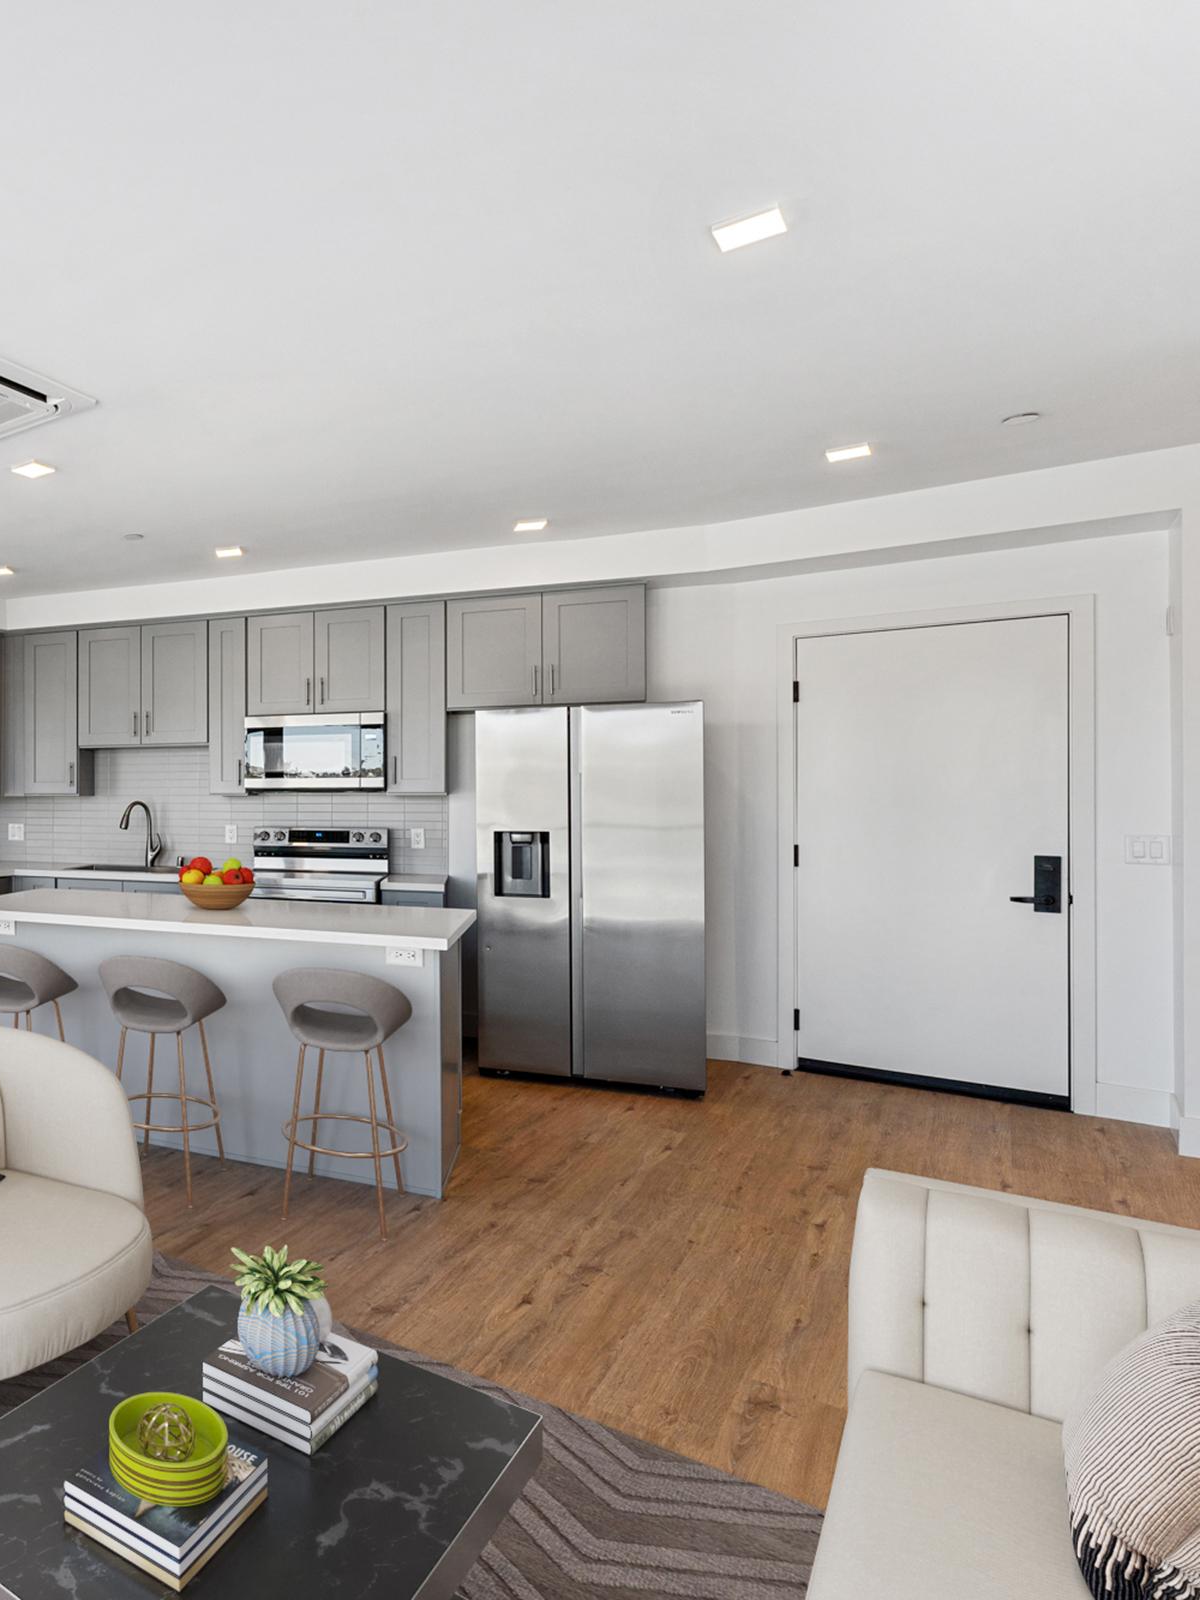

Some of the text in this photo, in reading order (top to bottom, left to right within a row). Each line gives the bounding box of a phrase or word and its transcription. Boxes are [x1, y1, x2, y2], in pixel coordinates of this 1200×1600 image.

[218, 1354, 257, 1373] ASPIRING
[256, 1371, 275, 1382] FOR
[275, 1380, 292, 1391] TIPS
[294, 1388, 310, 1398] 101
[227, 1444, 258, 1465] OUSE
